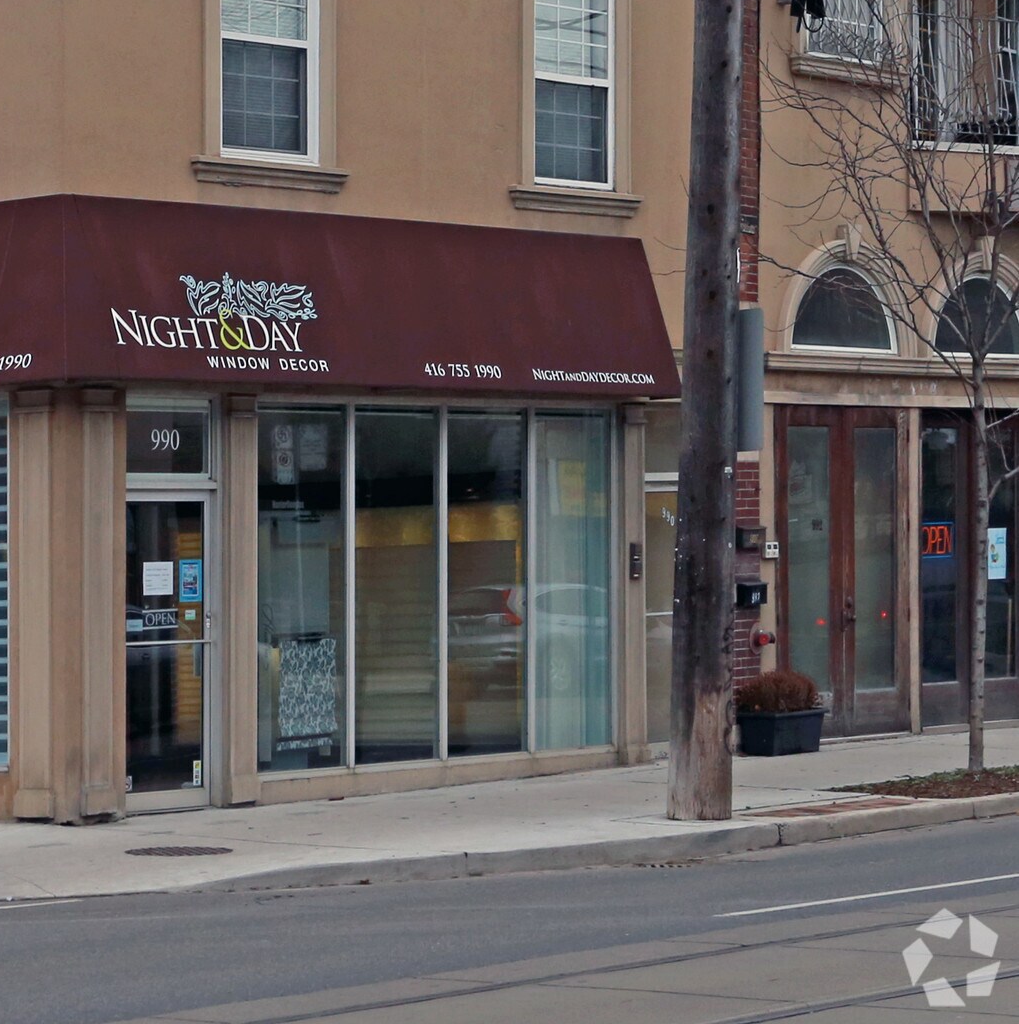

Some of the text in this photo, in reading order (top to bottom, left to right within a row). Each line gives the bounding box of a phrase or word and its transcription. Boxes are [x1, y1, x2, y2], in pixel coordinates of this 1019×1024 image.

[206, 356, 329, 372] WINDOW DECOR
[424, 363, 502, 379] 416 755 1990
[150, 428, 180, 451] 990
[661, 507, 675, 526] 990
[145, 612, 176, 626] OPEN
